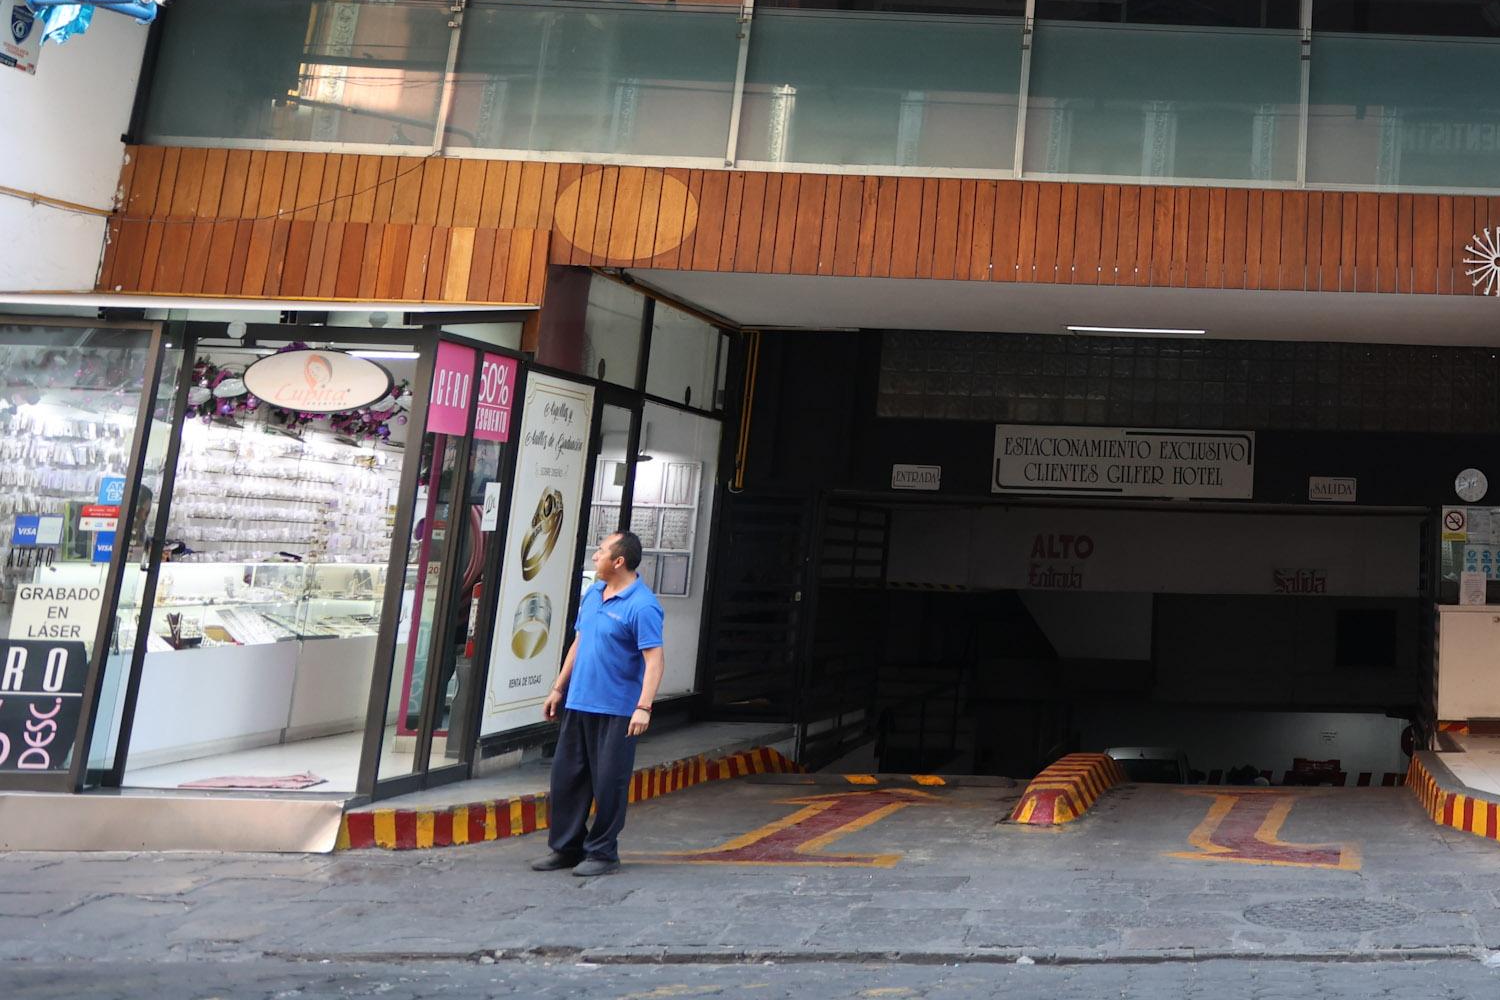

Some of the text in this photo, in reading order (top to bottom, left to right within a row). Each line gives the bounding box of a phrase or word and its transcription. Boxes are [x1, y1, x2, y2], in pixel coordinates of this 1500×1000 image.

[478, 361, 510, 405] 50%
[475, 407, 507, 433] ESCUENTO
[1003, 437, 1245, 462] ESTACIONAMIENTO EXCLUSIVO
[896, 471, 936, 483] ENTRADA
[1024, 462, 1223, 487] CLIENTES GILFER HOTEL
[1313, 483, 1352, 496] SALIDA
[18, 527, 37, 536] VISA
[97, 544, 113, 552] VISA
[1030, 534, 1095, 560] ALTO
[1273, 568, 1328, 593] Salida
[20, 587, 100, 601] GRABADO
[47, 606, 69, 619] EN
[28, 621, 81, 638] LÁSER
